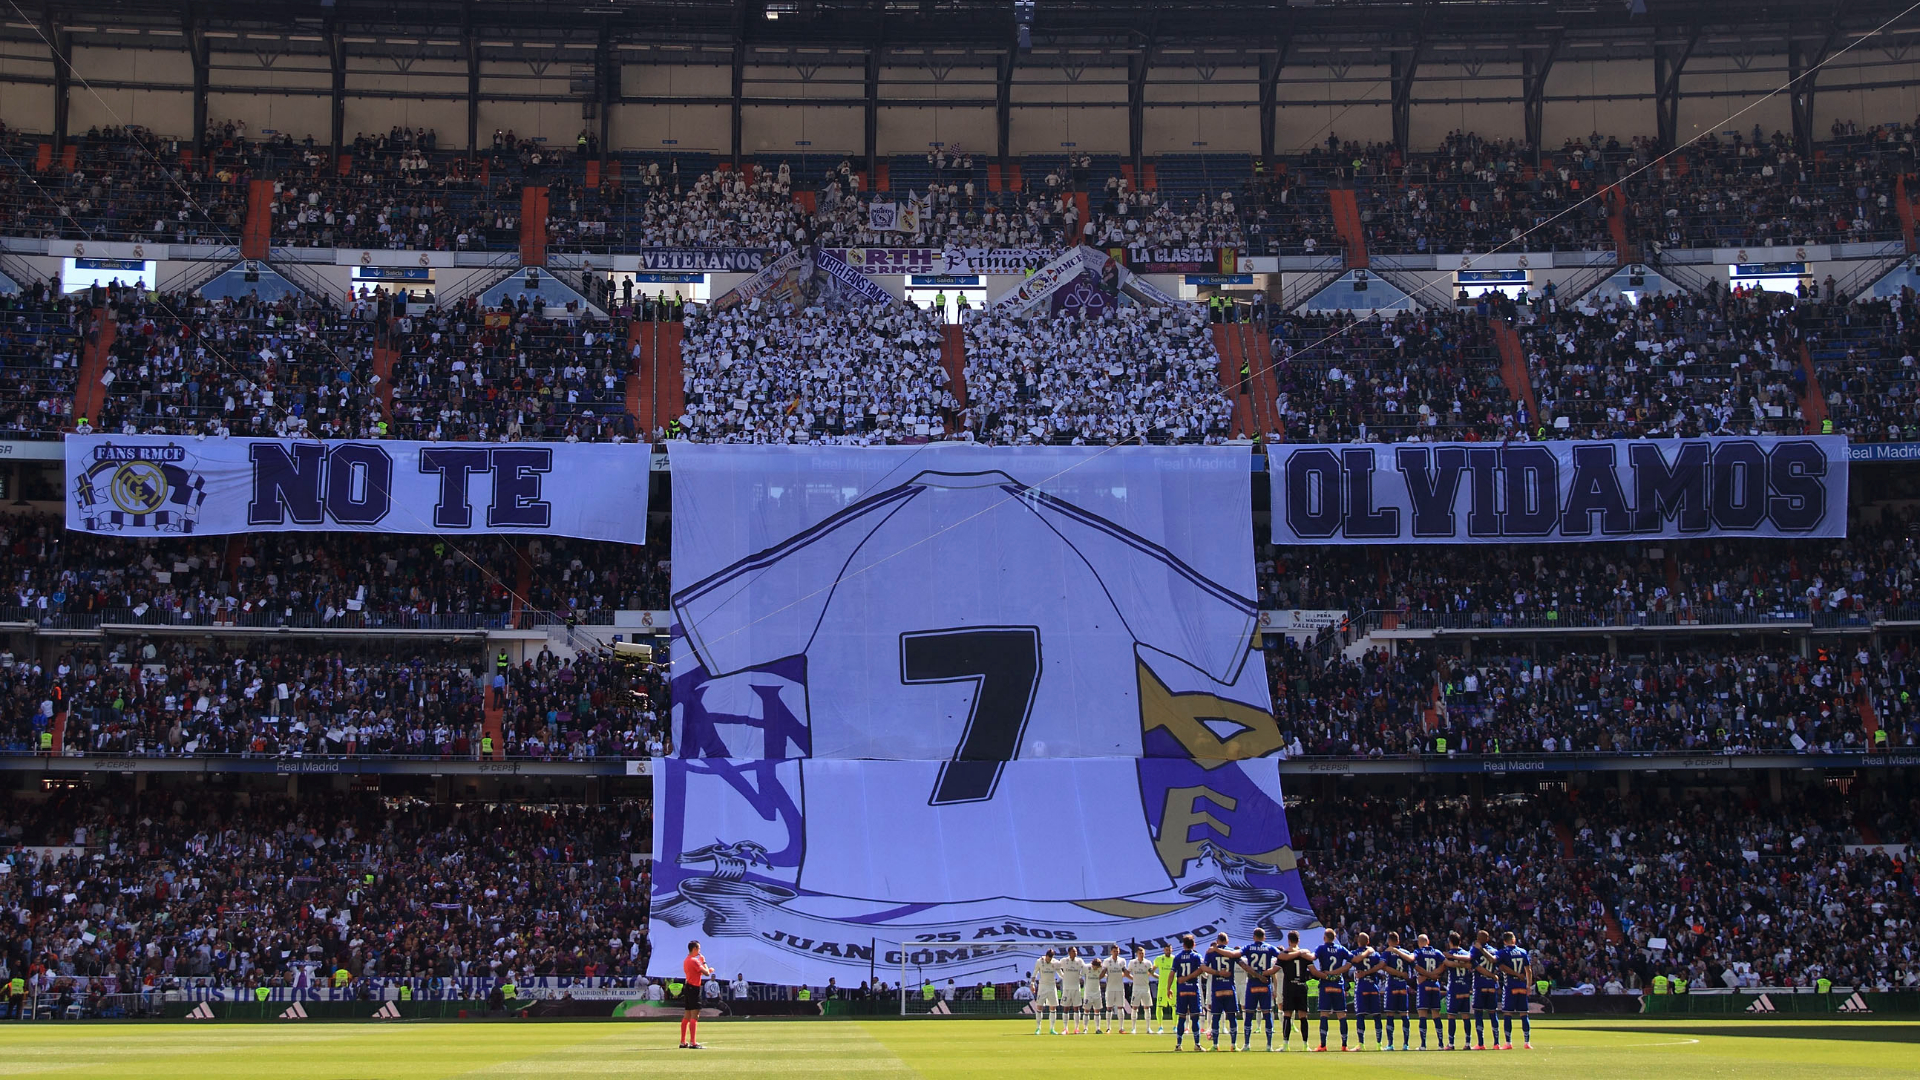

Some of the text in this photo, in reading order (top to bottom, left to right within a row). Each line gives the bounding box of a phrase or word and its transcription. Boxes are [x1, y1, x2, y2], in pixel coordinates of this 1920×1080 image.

[643, 251, 761, 270] VETERANOS
[1131, 248, 1150, 262] LA
[818, 251, 893, 307] NORTH FANS RMCF
[97, 447, 183, 460] FANS RMCF
[1842, 446, 1872, 459] Real
[248, 442, 554, 530] NO TE
[1285, 441, 1828, 540] OLVIDAMOS
[900, 625, 1042, 808] 7
[276, 760, 339, 772] Real Madrid
[1319, 762, 1349, 772] CEPSA
[1483, 759, 1544, 771] Real Madrid
[1694, 758, 1724, 767] CEPSA
[1861, 755, 1885, 766] Real
[915, 921, 1078, 943] 25 AÑOS
[762, 930, 873, 961] JUAN
[1180, 962, 1192, 977] 11
[1215, 956, 1230, 973] 15
[1250, 952, 1267, 971] 24
[1293, 959, 1301, 977] 1
[1329, 955, 1338, 972] 2
[1396, 958, 1404, 973] 8
[1424, 957, 1437, 973] 18
[1511, 957, 1524, 974] 17
